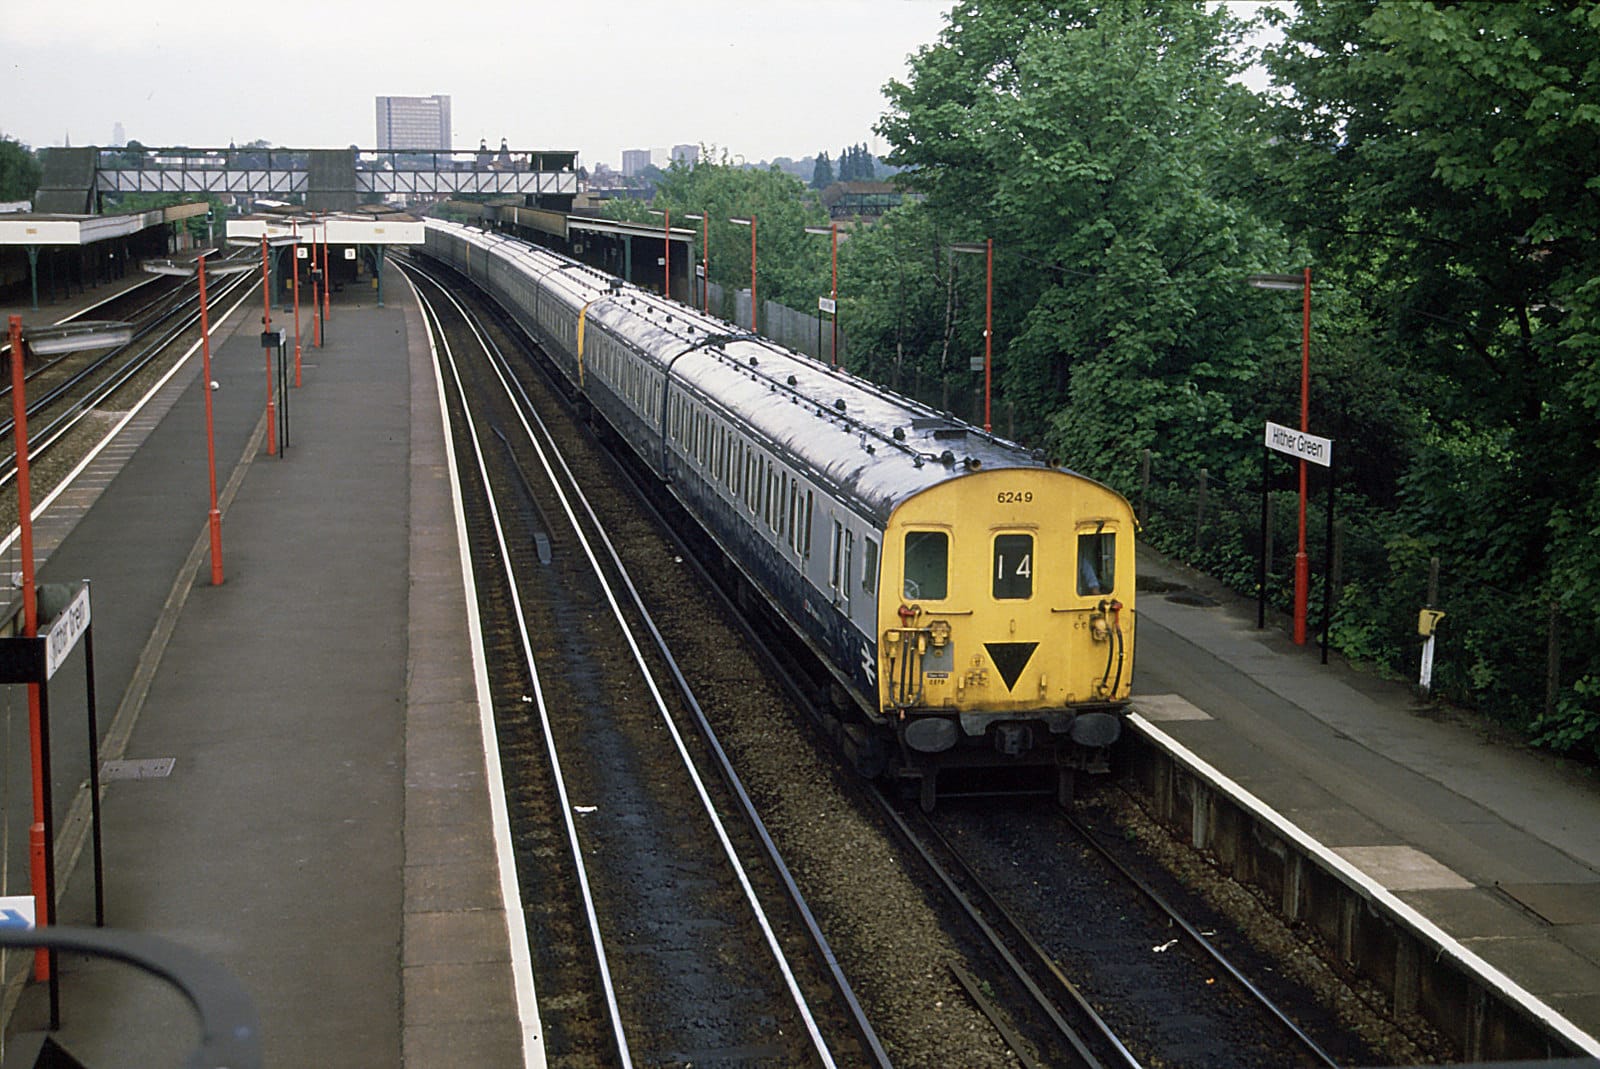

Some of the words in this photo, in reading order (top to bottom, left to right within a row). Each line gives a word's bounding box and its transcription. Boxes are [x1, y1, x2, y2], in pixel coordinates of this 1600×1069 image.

[1272, 426, 1296, 450] Hither
[1297, 435, 1323, 458] Green
[997, 491, 1033, 503] 6249
[1428, 611, 1439, 628] 7
